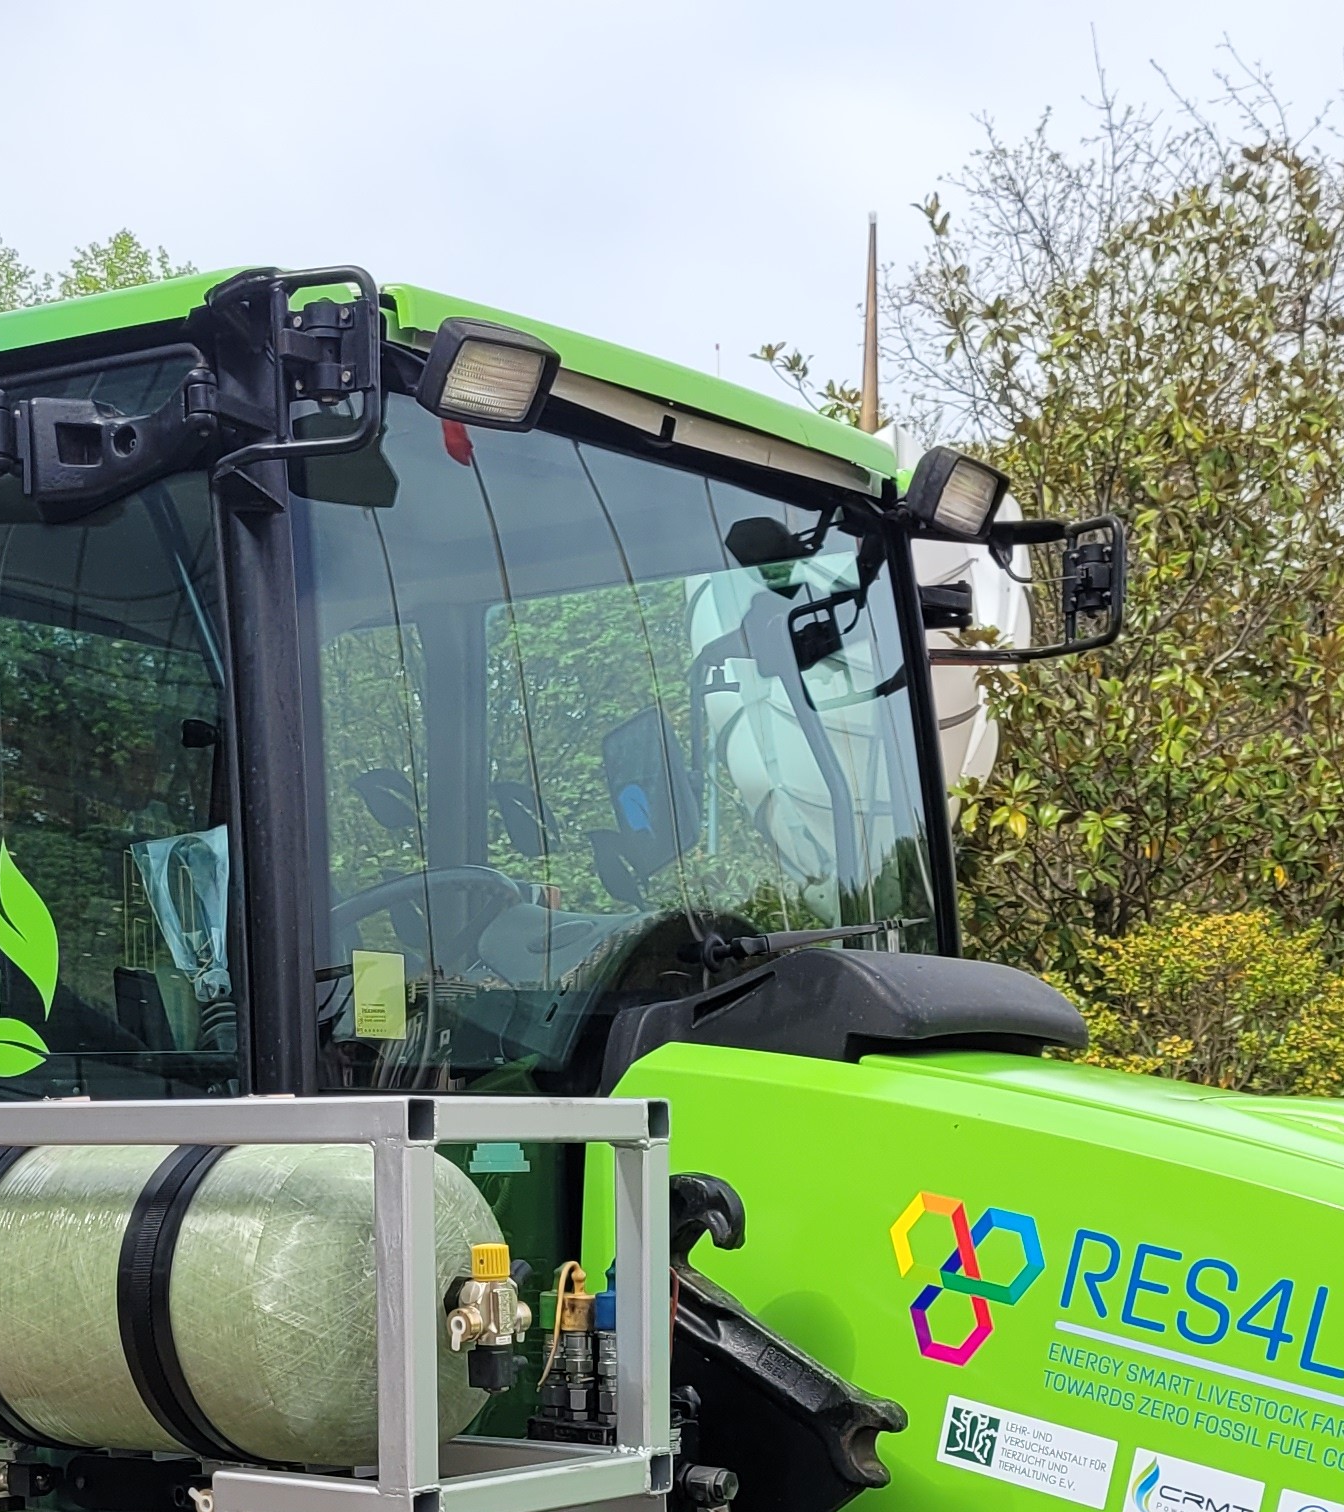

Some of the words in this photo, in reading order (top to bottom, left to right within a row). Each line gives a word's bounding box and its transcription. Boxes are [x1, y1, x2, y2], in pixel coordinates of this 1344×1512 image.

[1048, 1343, 1124, 1377] ENERGY
[1126, 1364, 1194, 1397] SMART
[1196, 1381, 1307, 1430] LIVESTOCK
[1006, 1421, 1031, 1437] LEHR-
[1032, 1429, 1053, 1443] UND
[1043, 1370, 1135, 1411] TOWARDS
[1138, 1397, 1191, 1427] ZERO
[1193, 1412, 1262, 1449] FOSSIL
[1267, 1433, 1318, 1464] FUEL
[1000, 1447, 1046, 1470] TIERZUCHT
[1048, 1460, 1068, 1475] UND
[1004, 1434, 1089, 1468] VERSUCHSANSTALT
[1089, 1456, 1107, 1472] FÜR
[998, 1460, 1057, 1485] TIERHALTUNG
[1059, 1478, 1076, 1492] E.V.
